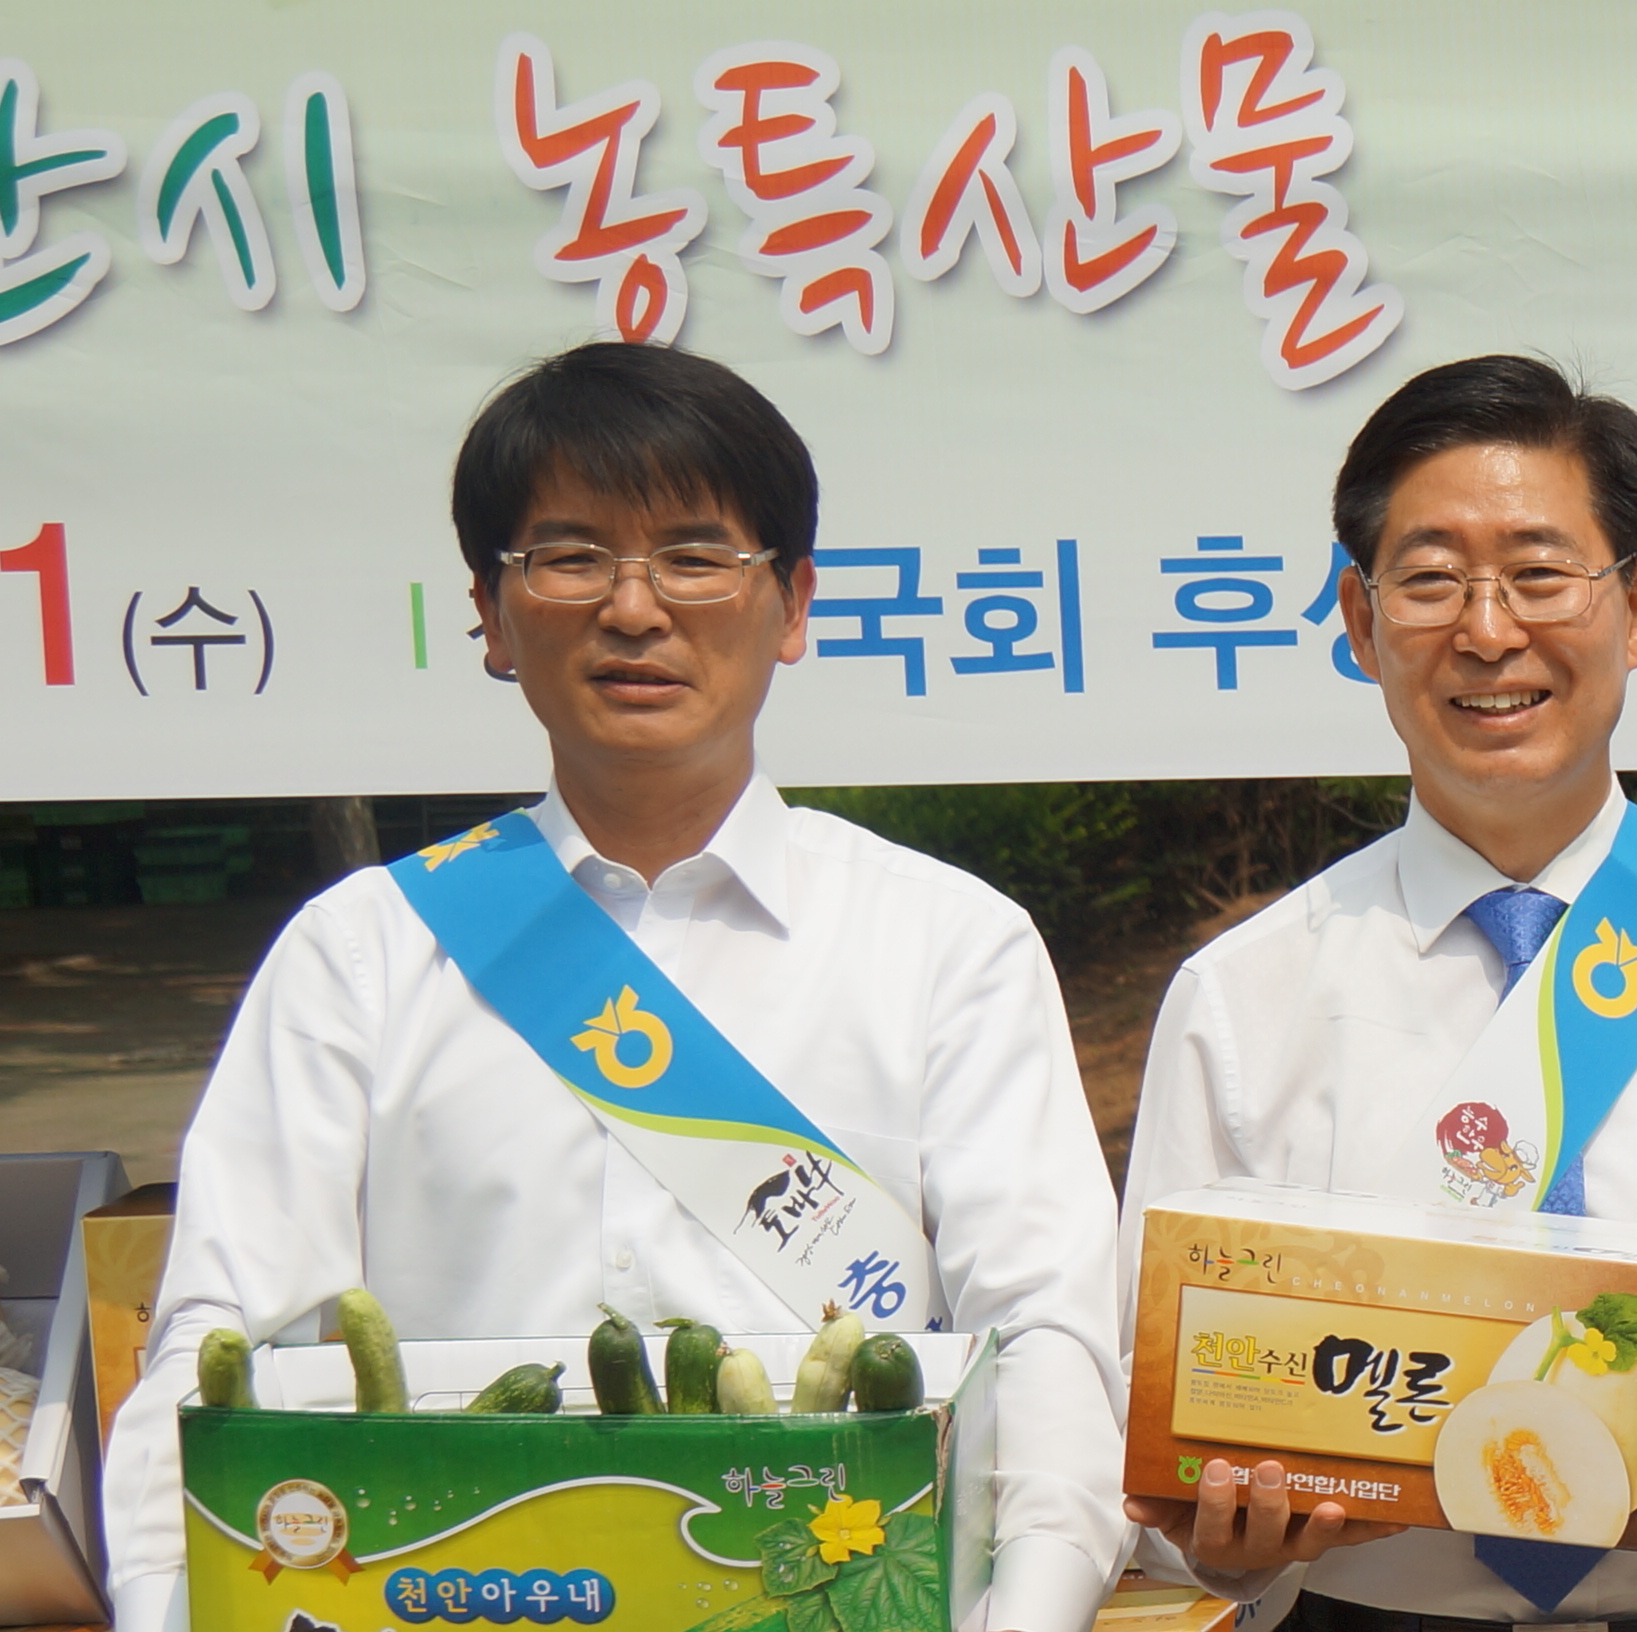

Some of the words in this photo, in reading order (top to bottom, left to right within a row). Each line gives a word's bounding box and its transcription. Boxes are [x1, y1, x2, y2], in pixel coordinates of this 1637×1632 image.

[516, 26, 1386, 370] 농특산물
[812, 537, 1087, 697] 국회
[1188, 1243, 1282, 1284] 하늘그린
[1313, 1334, 1452, 1433] 멜론
[723, 1463, 847, 1508] 하늘그린
